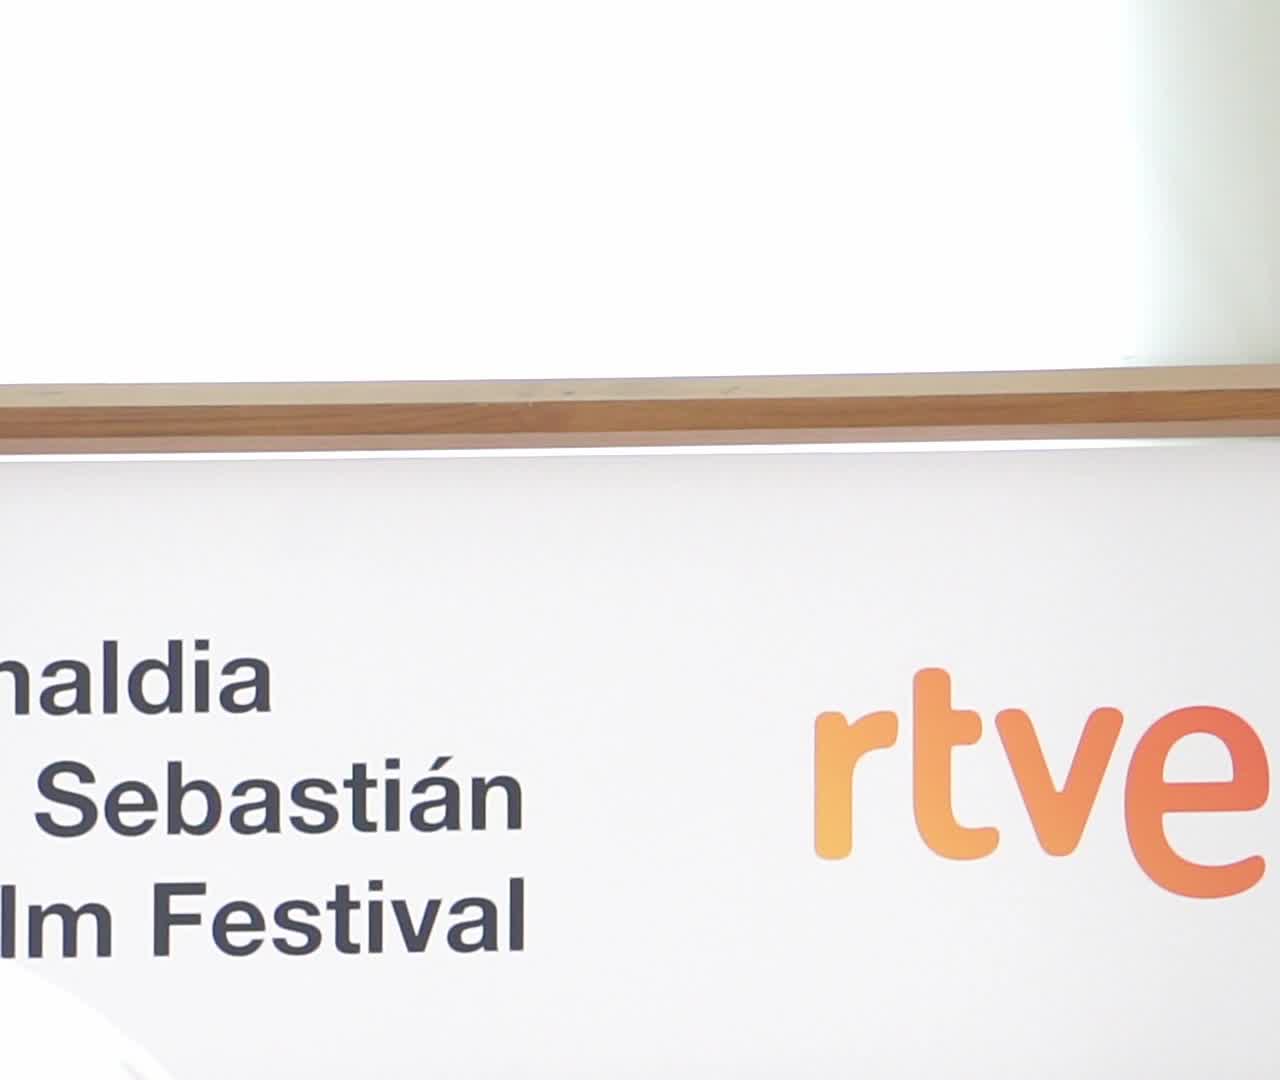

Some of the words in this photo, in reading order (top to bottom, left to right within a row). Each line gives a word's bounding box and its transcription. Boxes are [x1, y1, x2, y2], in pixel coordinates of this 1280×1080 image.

[34, 756, 523, 838] Sebastián
[813, 667, 1271, 900] rtve
[153, 877, 525, 957] Festival
